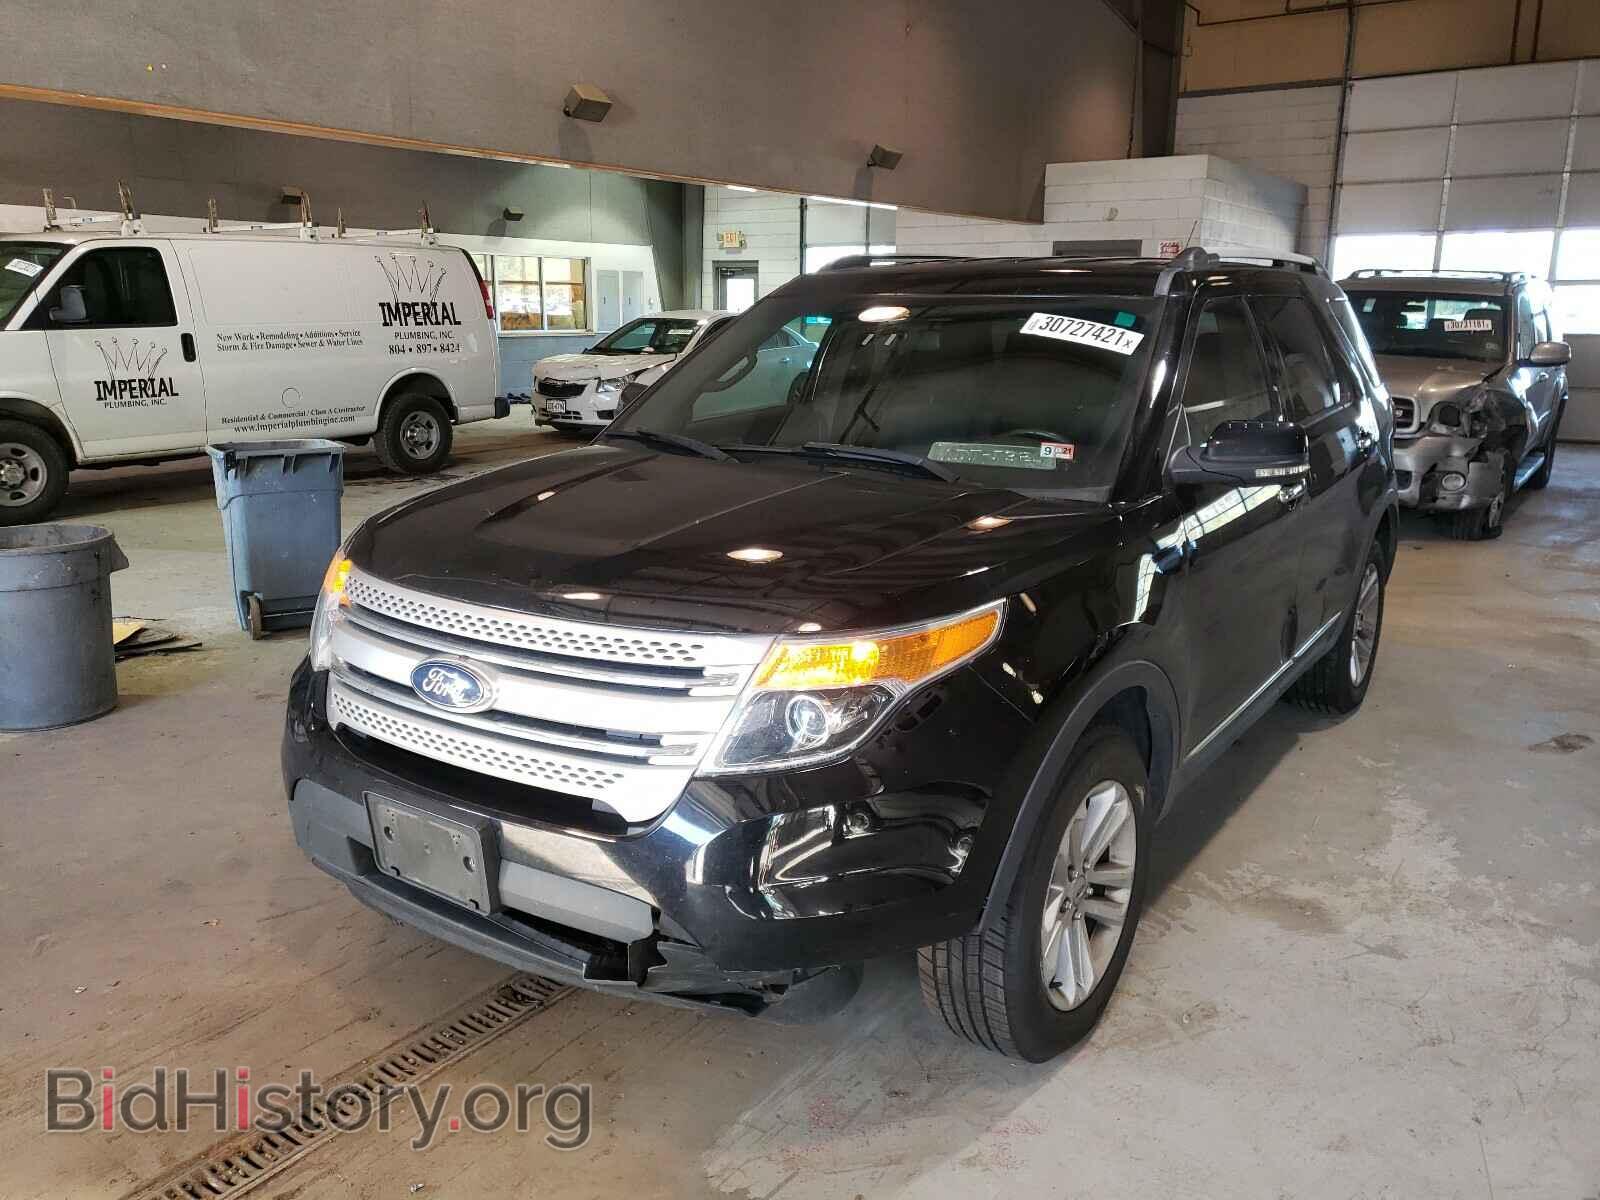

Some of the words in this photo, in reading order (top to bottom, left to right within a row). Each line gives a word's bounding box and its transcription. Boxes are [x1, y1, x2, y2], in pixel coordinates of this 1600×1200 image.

[378, 302, 462, 327] IMPERIAL
[216, 333, 232, 342] New
[234, 331, 255, 341] Work
[259, 329, 300, 341] Remodeling
[338, 328, 361, 338] Service
[394, 331, 438, 341] PLUMBING,
[1038, 316, 1127, 345] 30727421
[216, 342, 240, 352] Storm
[249, 341, 265, 350] Fire
[265, 340, 294, 350] Damage
[297, 339, 318, 348] Sewer
[326, 338, 345, 348] Water
[388, 344, 406, 355] 804
[416, 343, 432, 354] 897
[439, 342, 460, 354] 8424
[94, 377, 179, 401] IMPERIAL
[104, 399, 149, 409] PLUMBING,
[221, 414, 260, 425] Residential
[267, 409, 306, 421] Commercial
[1044, 446, 1052, 456] 9
